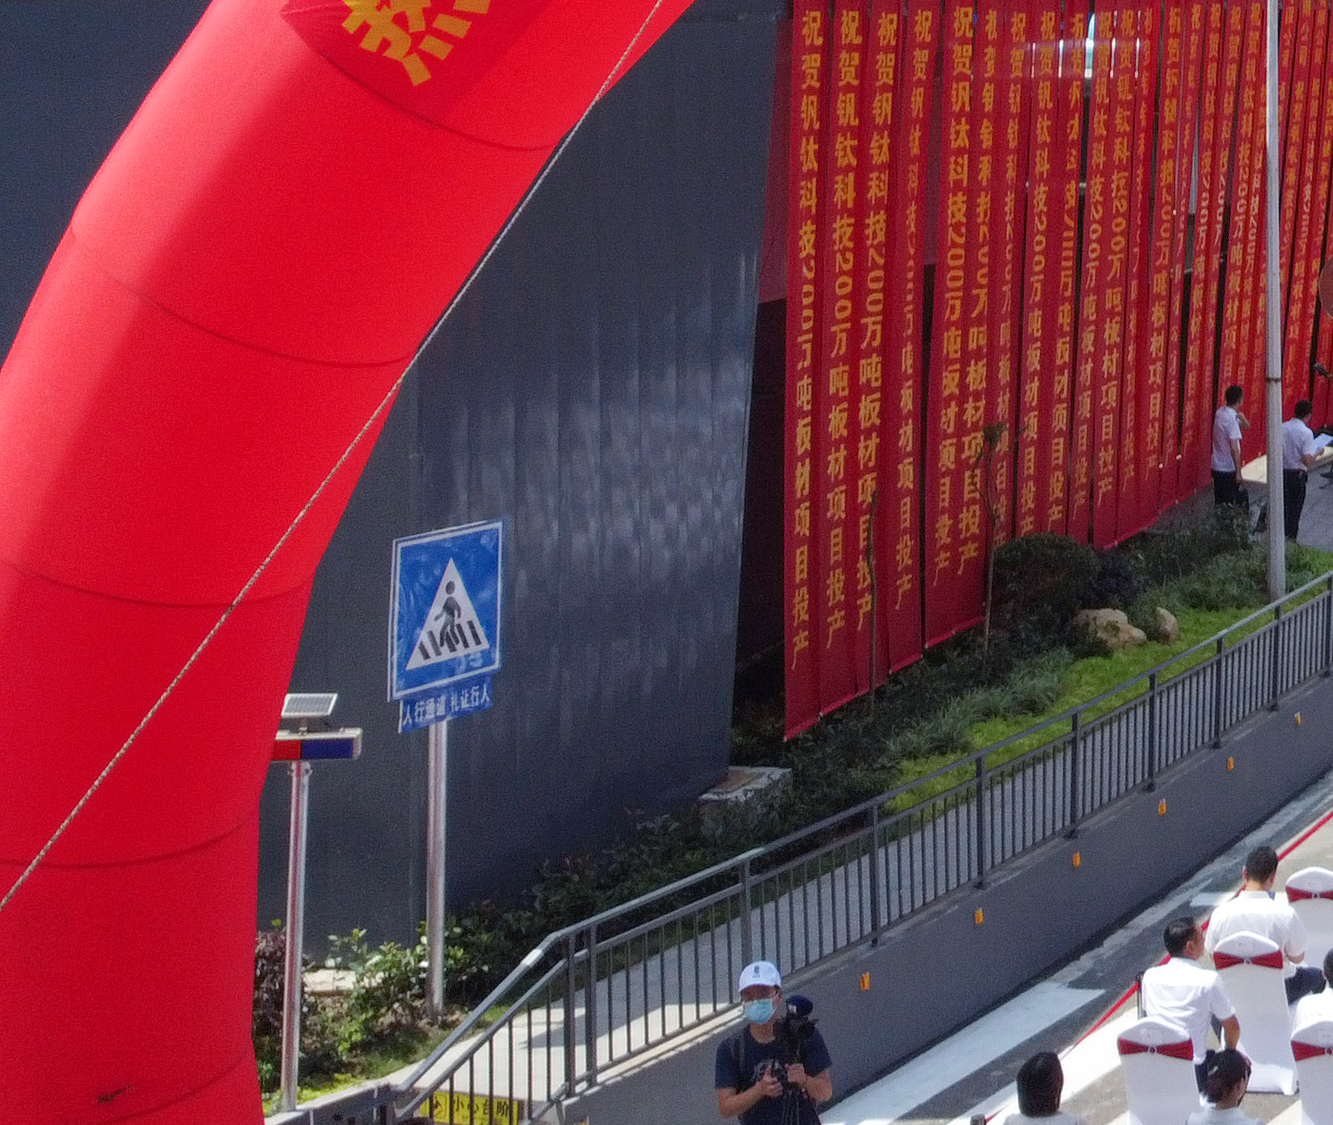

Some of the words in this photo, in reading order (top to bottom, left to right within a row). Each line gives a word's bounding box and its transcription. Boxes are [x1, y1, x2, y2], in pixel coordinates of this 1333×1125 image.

[792, 10, 823, 670] 祝贺钒钛科技200万吨板材项目投产
[827, 9, 862, 648] 祝贺钒钛科技200万吨板材项目投产
[1020, 11, 1056, 535] 祝贺钒钛科技200万吨板材项目投产
[1222, 3, 1261, 405] 祝贺钒钛科技200万吨板材项目
[402, 694, 447, 727] 人行通道
[449, 682, 491, 713] 礼让行人
